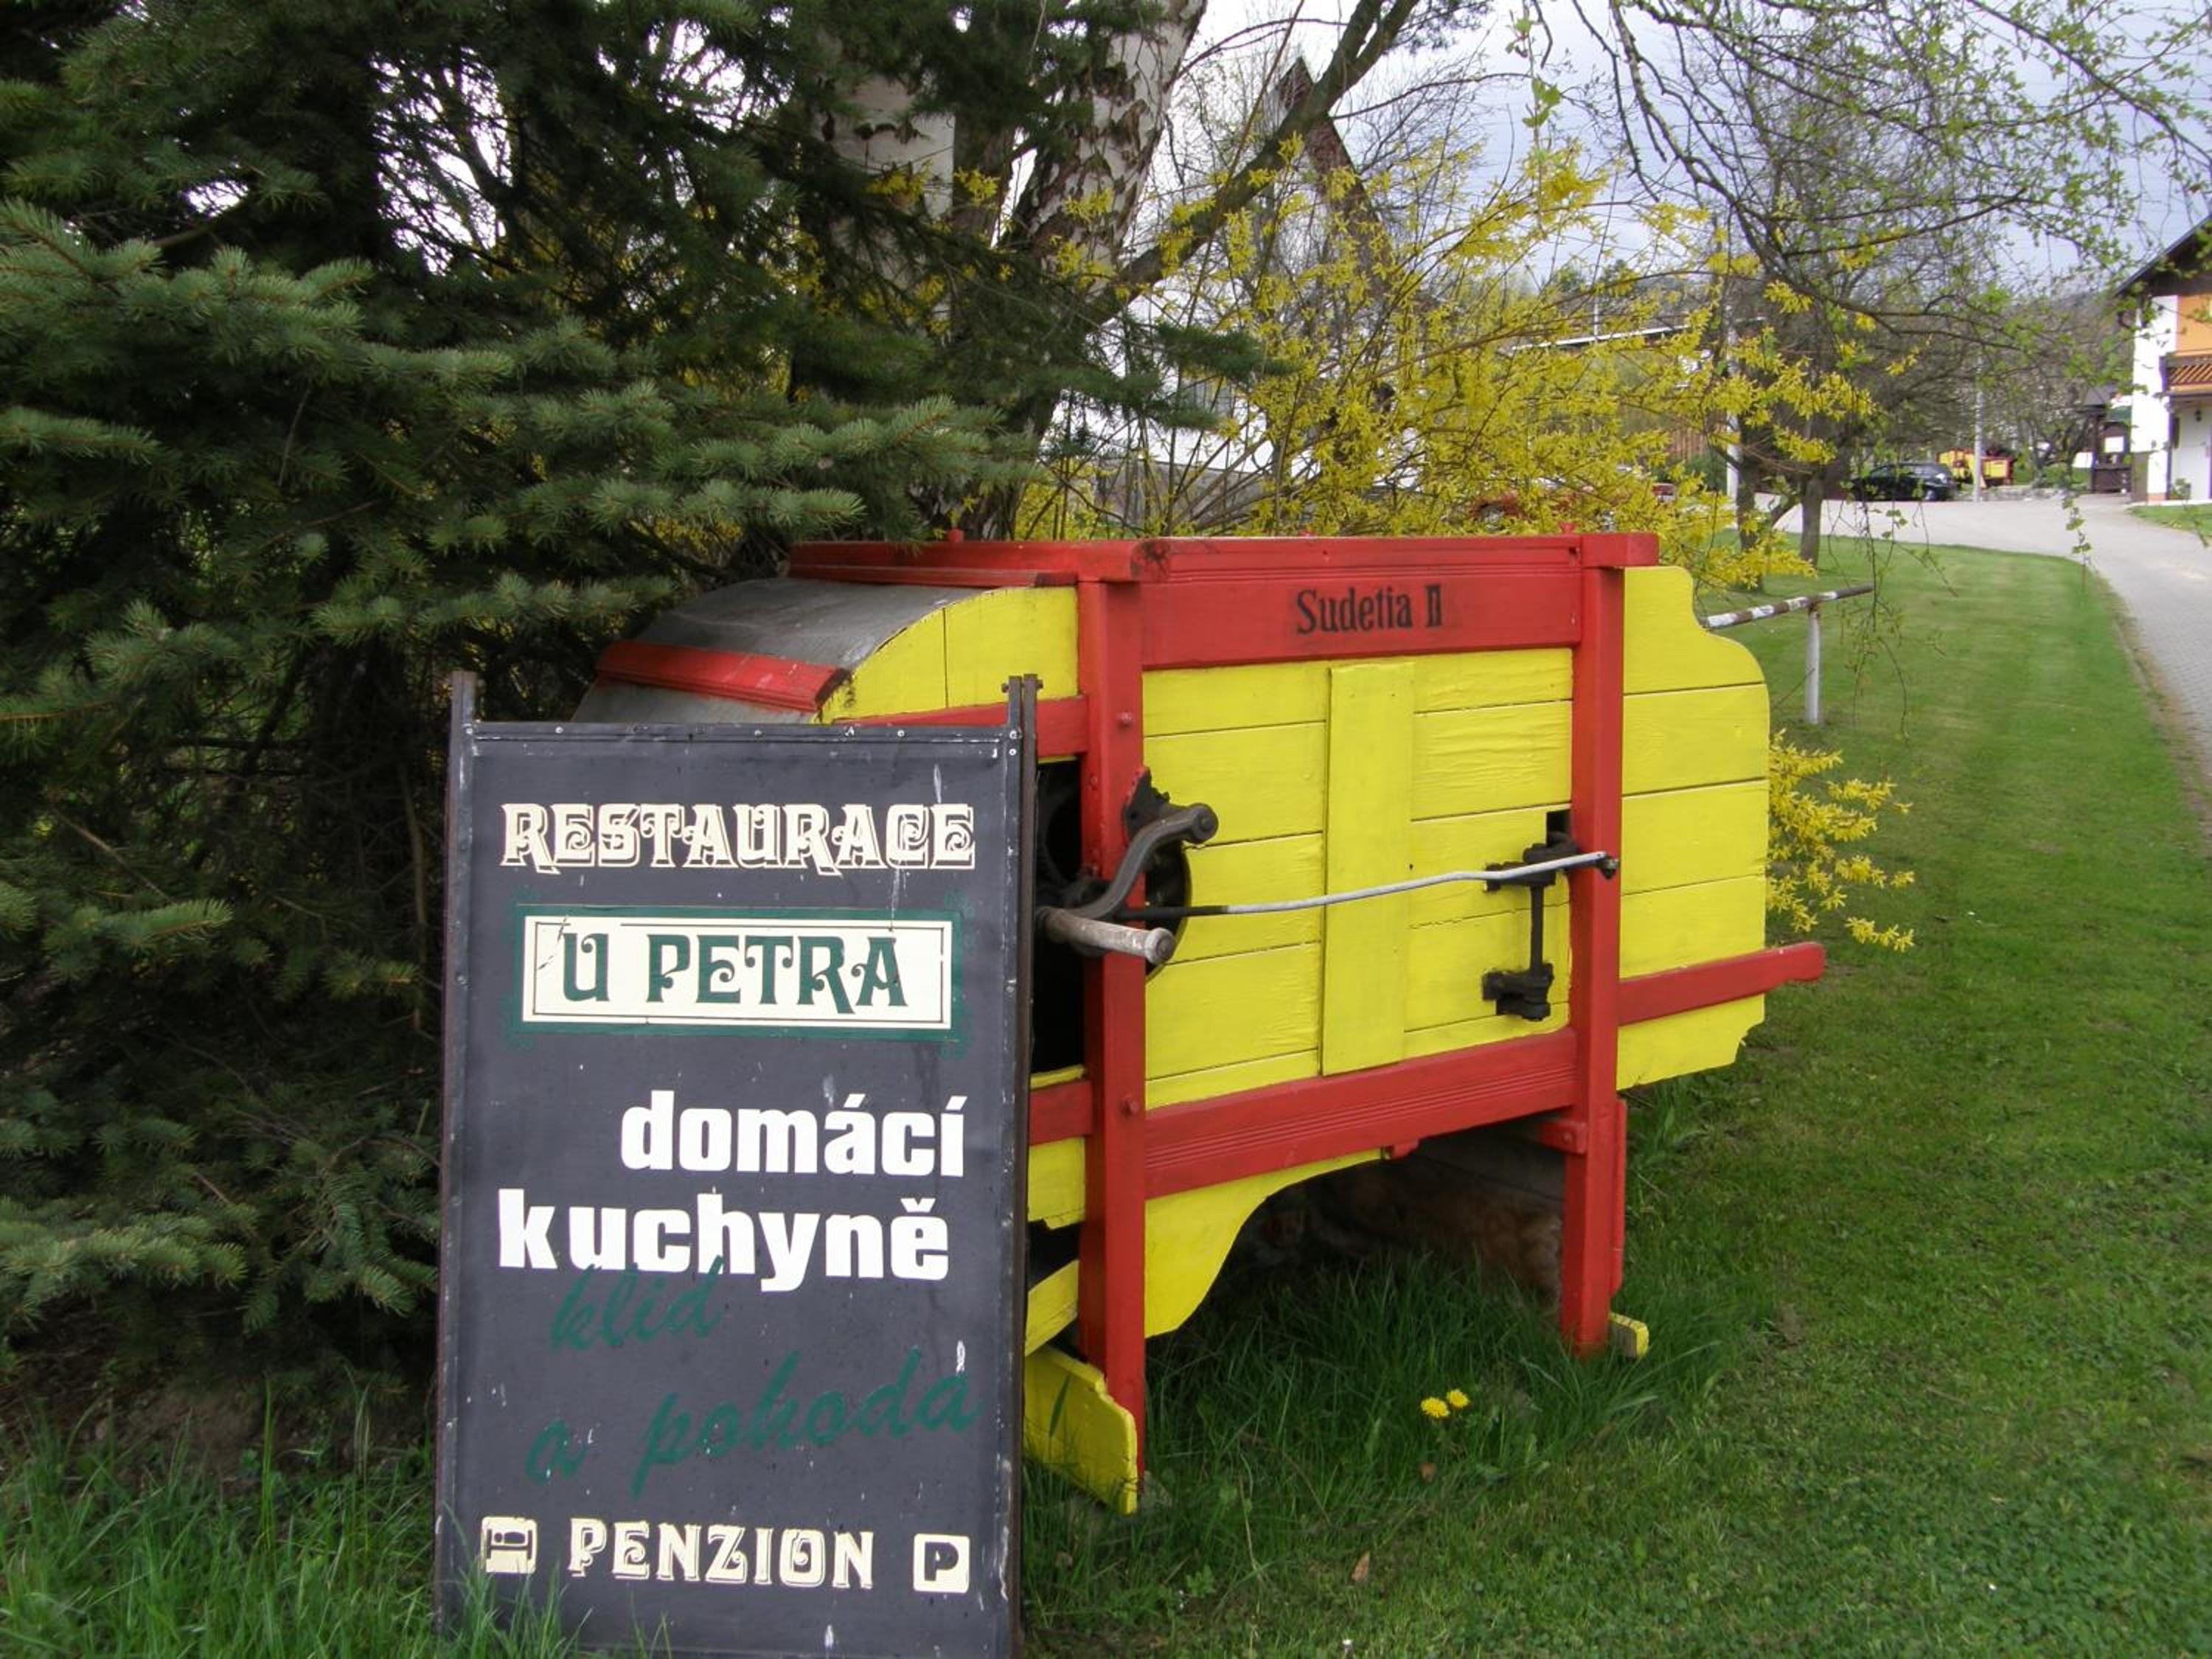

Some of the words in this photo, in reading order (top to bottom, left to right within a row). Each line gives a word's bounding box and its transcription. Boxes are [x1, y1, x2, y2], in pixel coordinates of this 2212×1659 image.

[1297, 586, 1413, 635] Sudetia
[499, 802, 976, 876] RESTAURACE
[562, 933, 611, 1002] U
[646, 933, 908, 1015] PETRA
[620, 1089, 968, 1178] domácí
[497, 1188, 950, 1293] kuchyně
[549, 1255, 725, 1354] klid
[524, 1416, 588, 1486] a
[630, 1346, 983, 1499] pohoda
[567, 1517, 874, 1590] PENZION
